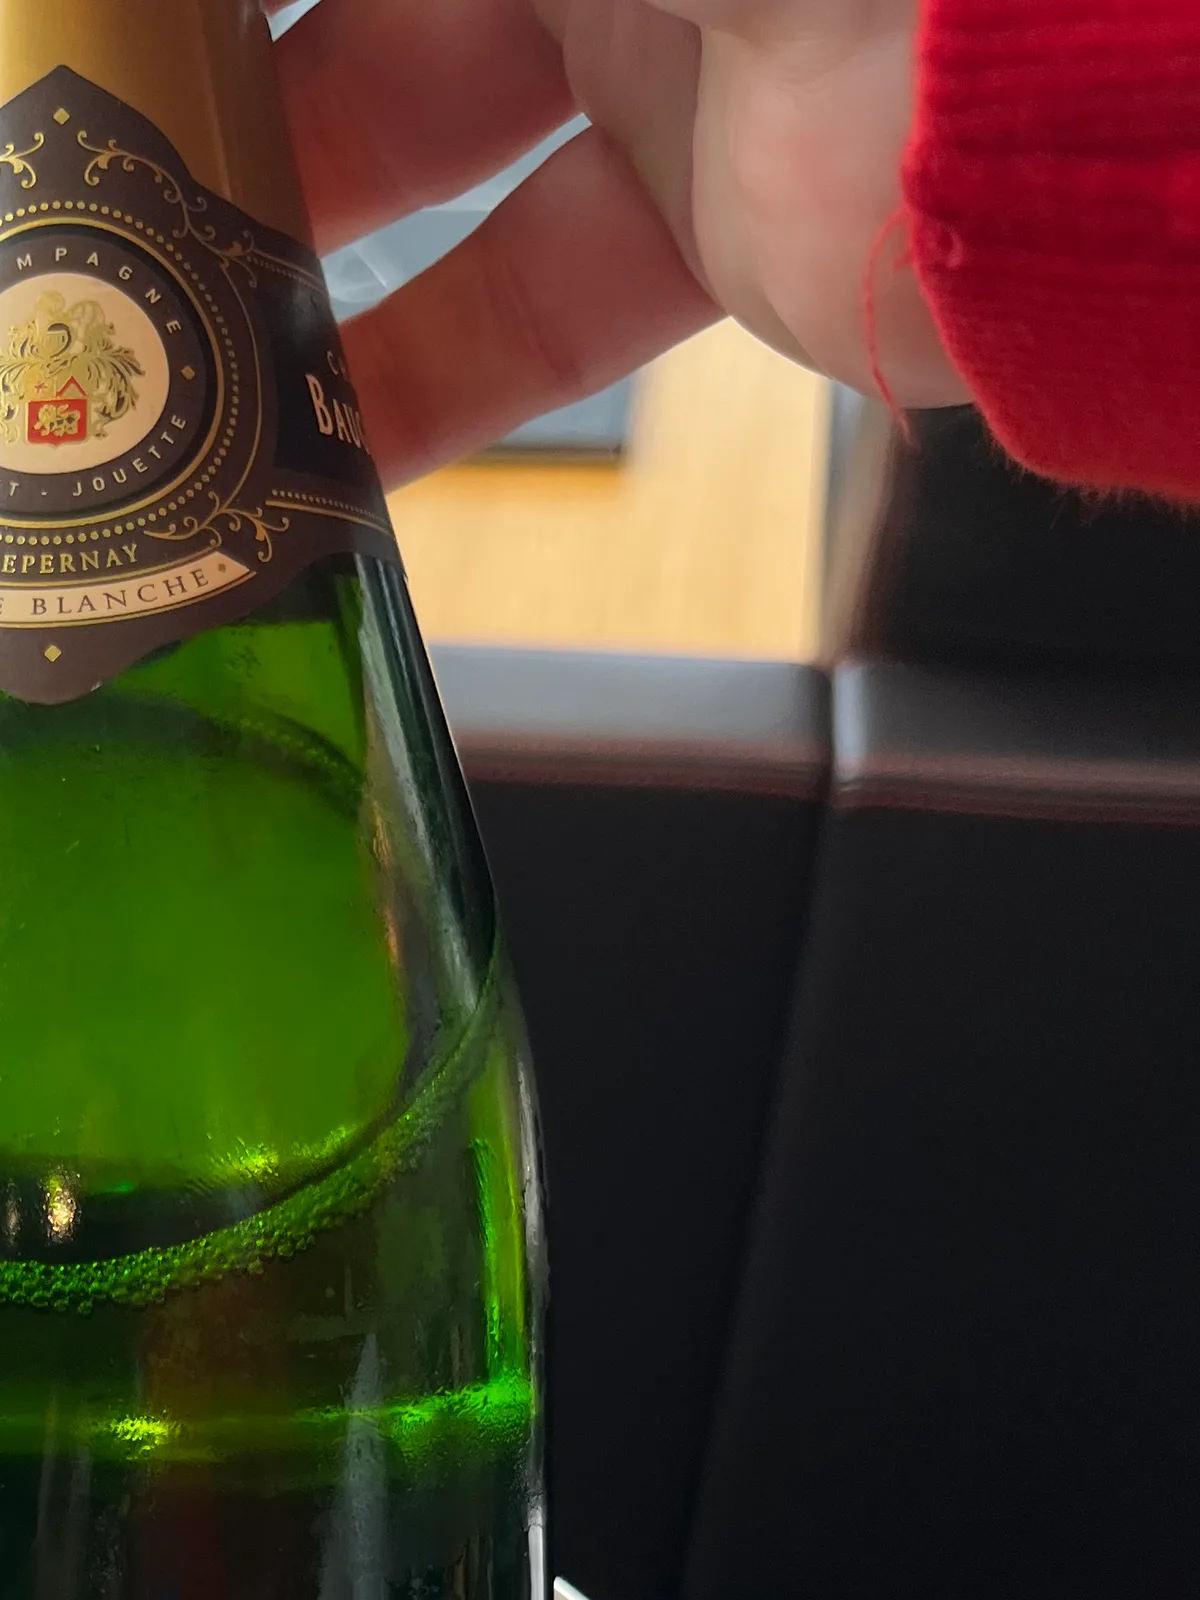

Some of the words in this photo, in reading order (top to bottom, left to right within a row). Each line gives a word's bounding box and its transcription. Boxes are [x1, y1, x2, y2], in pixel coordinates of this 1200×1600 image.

[72, 414, 187, 497] JOUETTE
[1, 543, 139, 575] EPERNAY
[30, 567, 210, 616] BLANCHE
